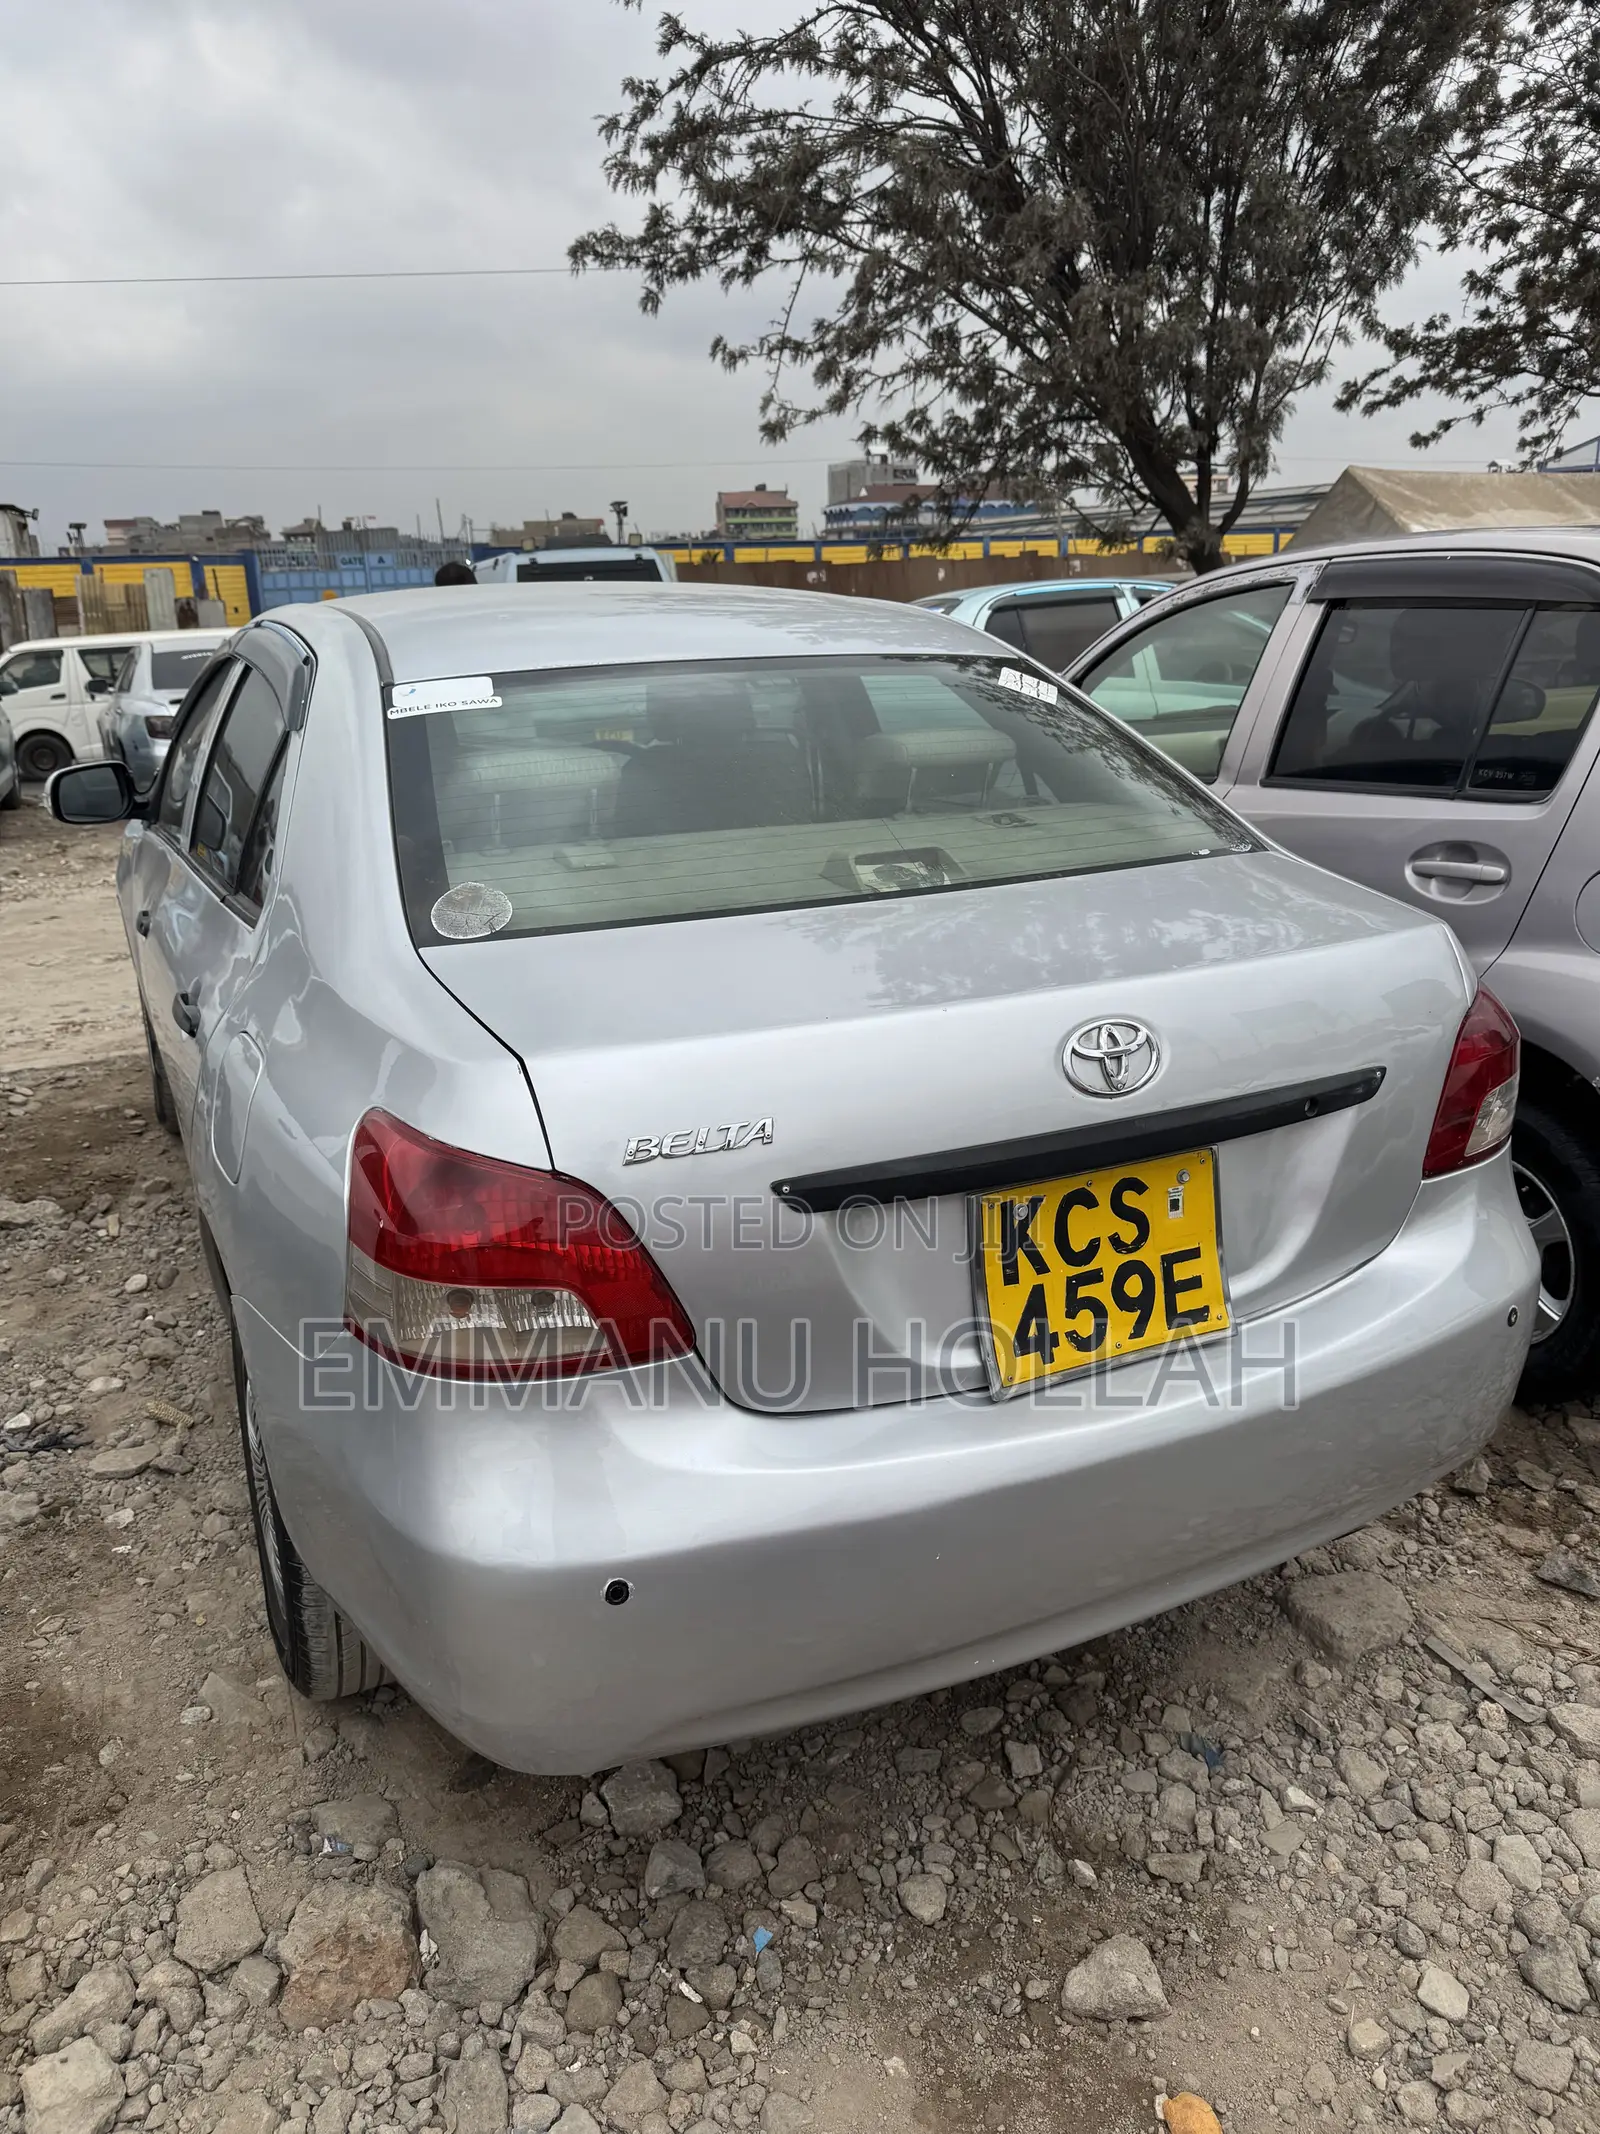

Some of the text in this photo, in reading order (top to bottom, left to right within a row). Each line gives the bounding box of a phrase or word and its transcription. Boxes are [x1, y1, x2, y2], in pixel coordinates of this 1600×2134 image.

[340, 555, 386, 566] GATE A
[390, 698, 498, 716] MBELE IKO SAWA
[622, 1117, 773, 1166] BELTA
[1000, 1177, 1150, 1286] KCS
[1013, 1247, 1210, 1365] 459E
